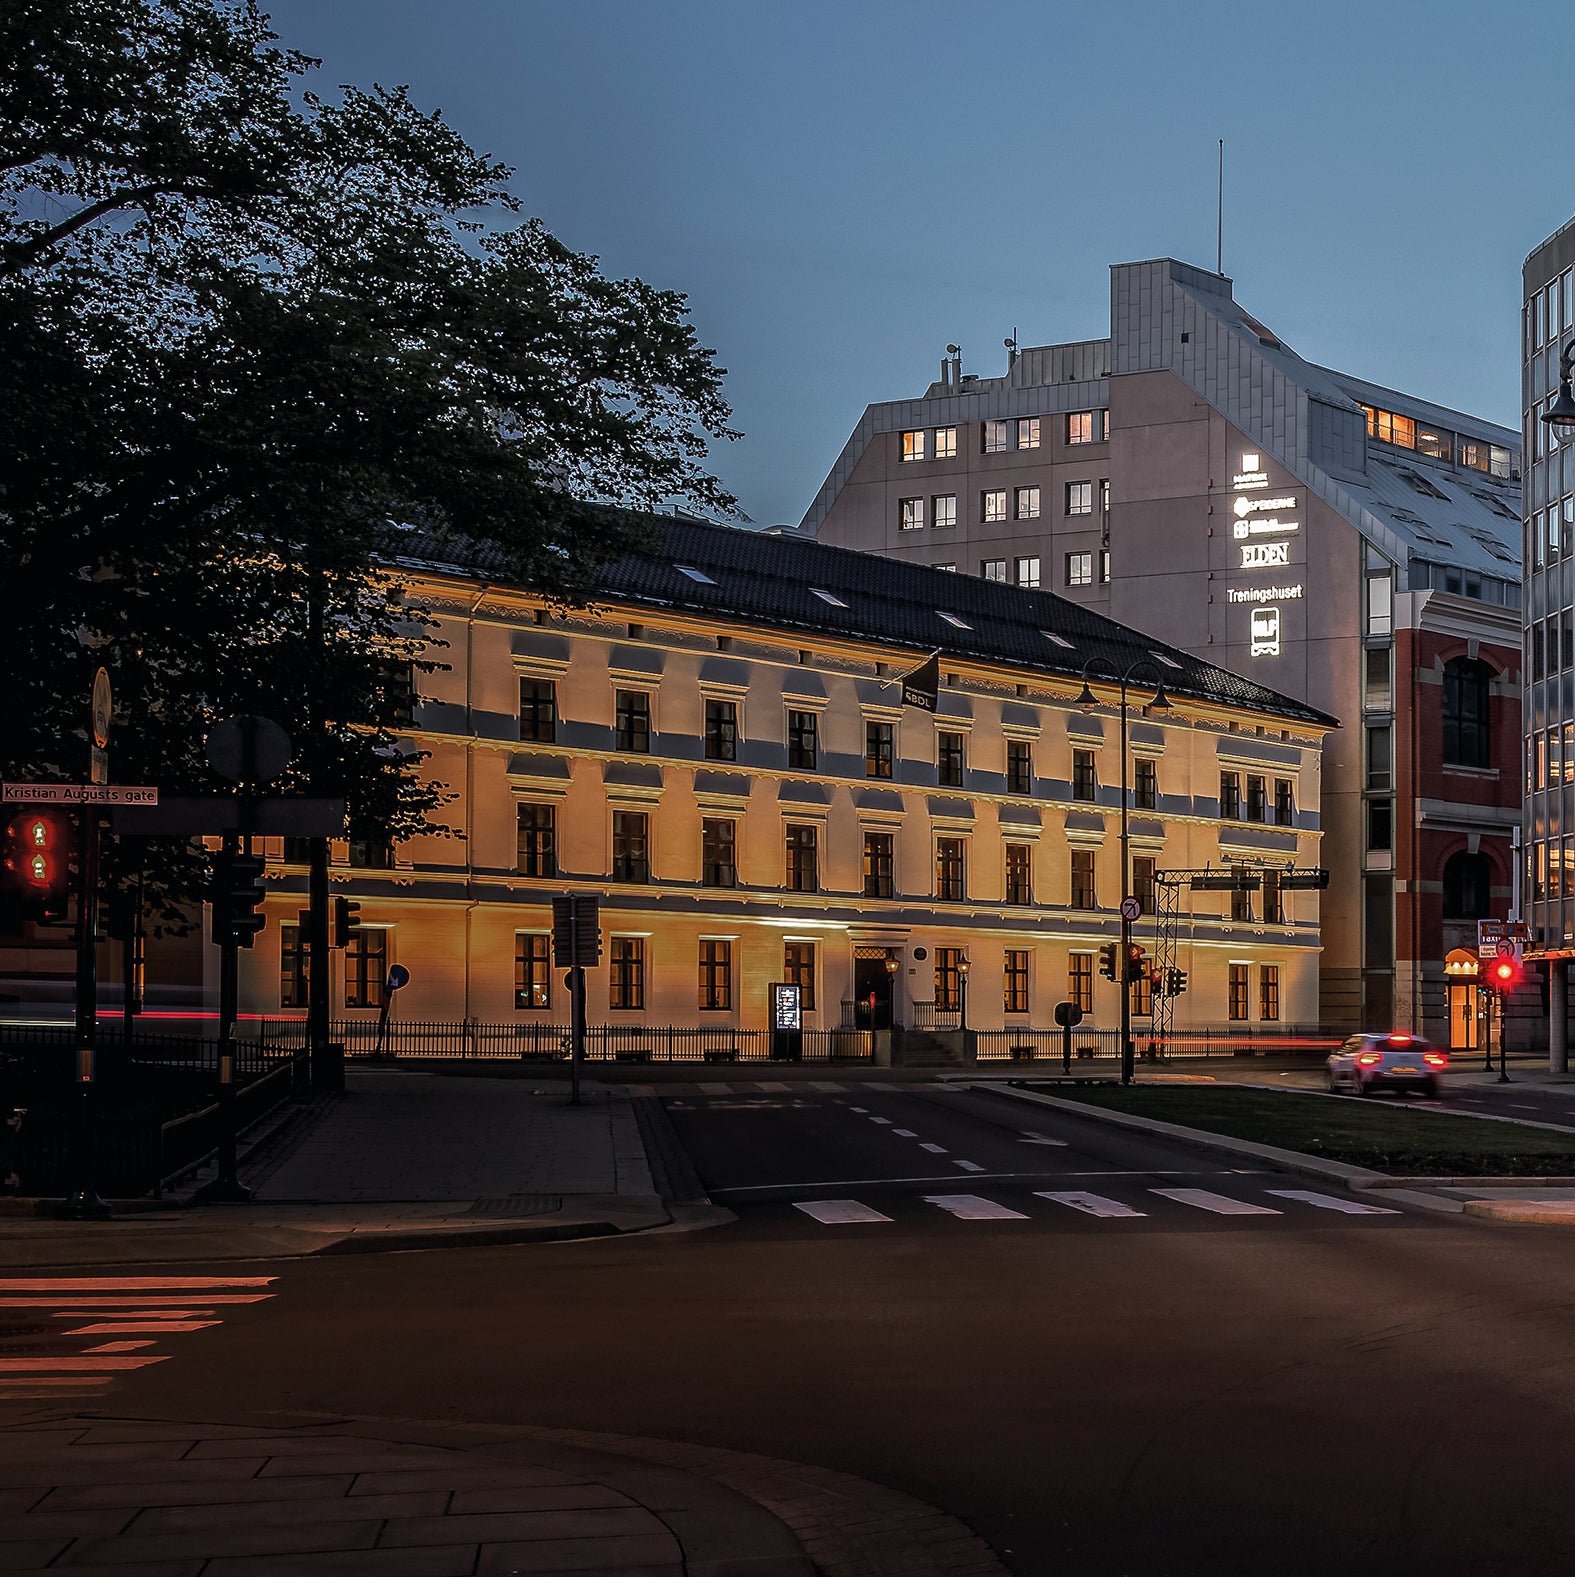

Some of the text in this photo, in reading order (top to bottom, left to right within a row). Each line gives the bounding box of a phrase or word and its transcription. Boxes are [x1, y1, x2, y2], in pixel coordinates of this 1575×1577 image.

[1241, 543, 1289, 567] ELDEN
[1227, 584, 1302, 603] Treningshuset
[5, 787, 155, 803] Kristian Augusts gate
